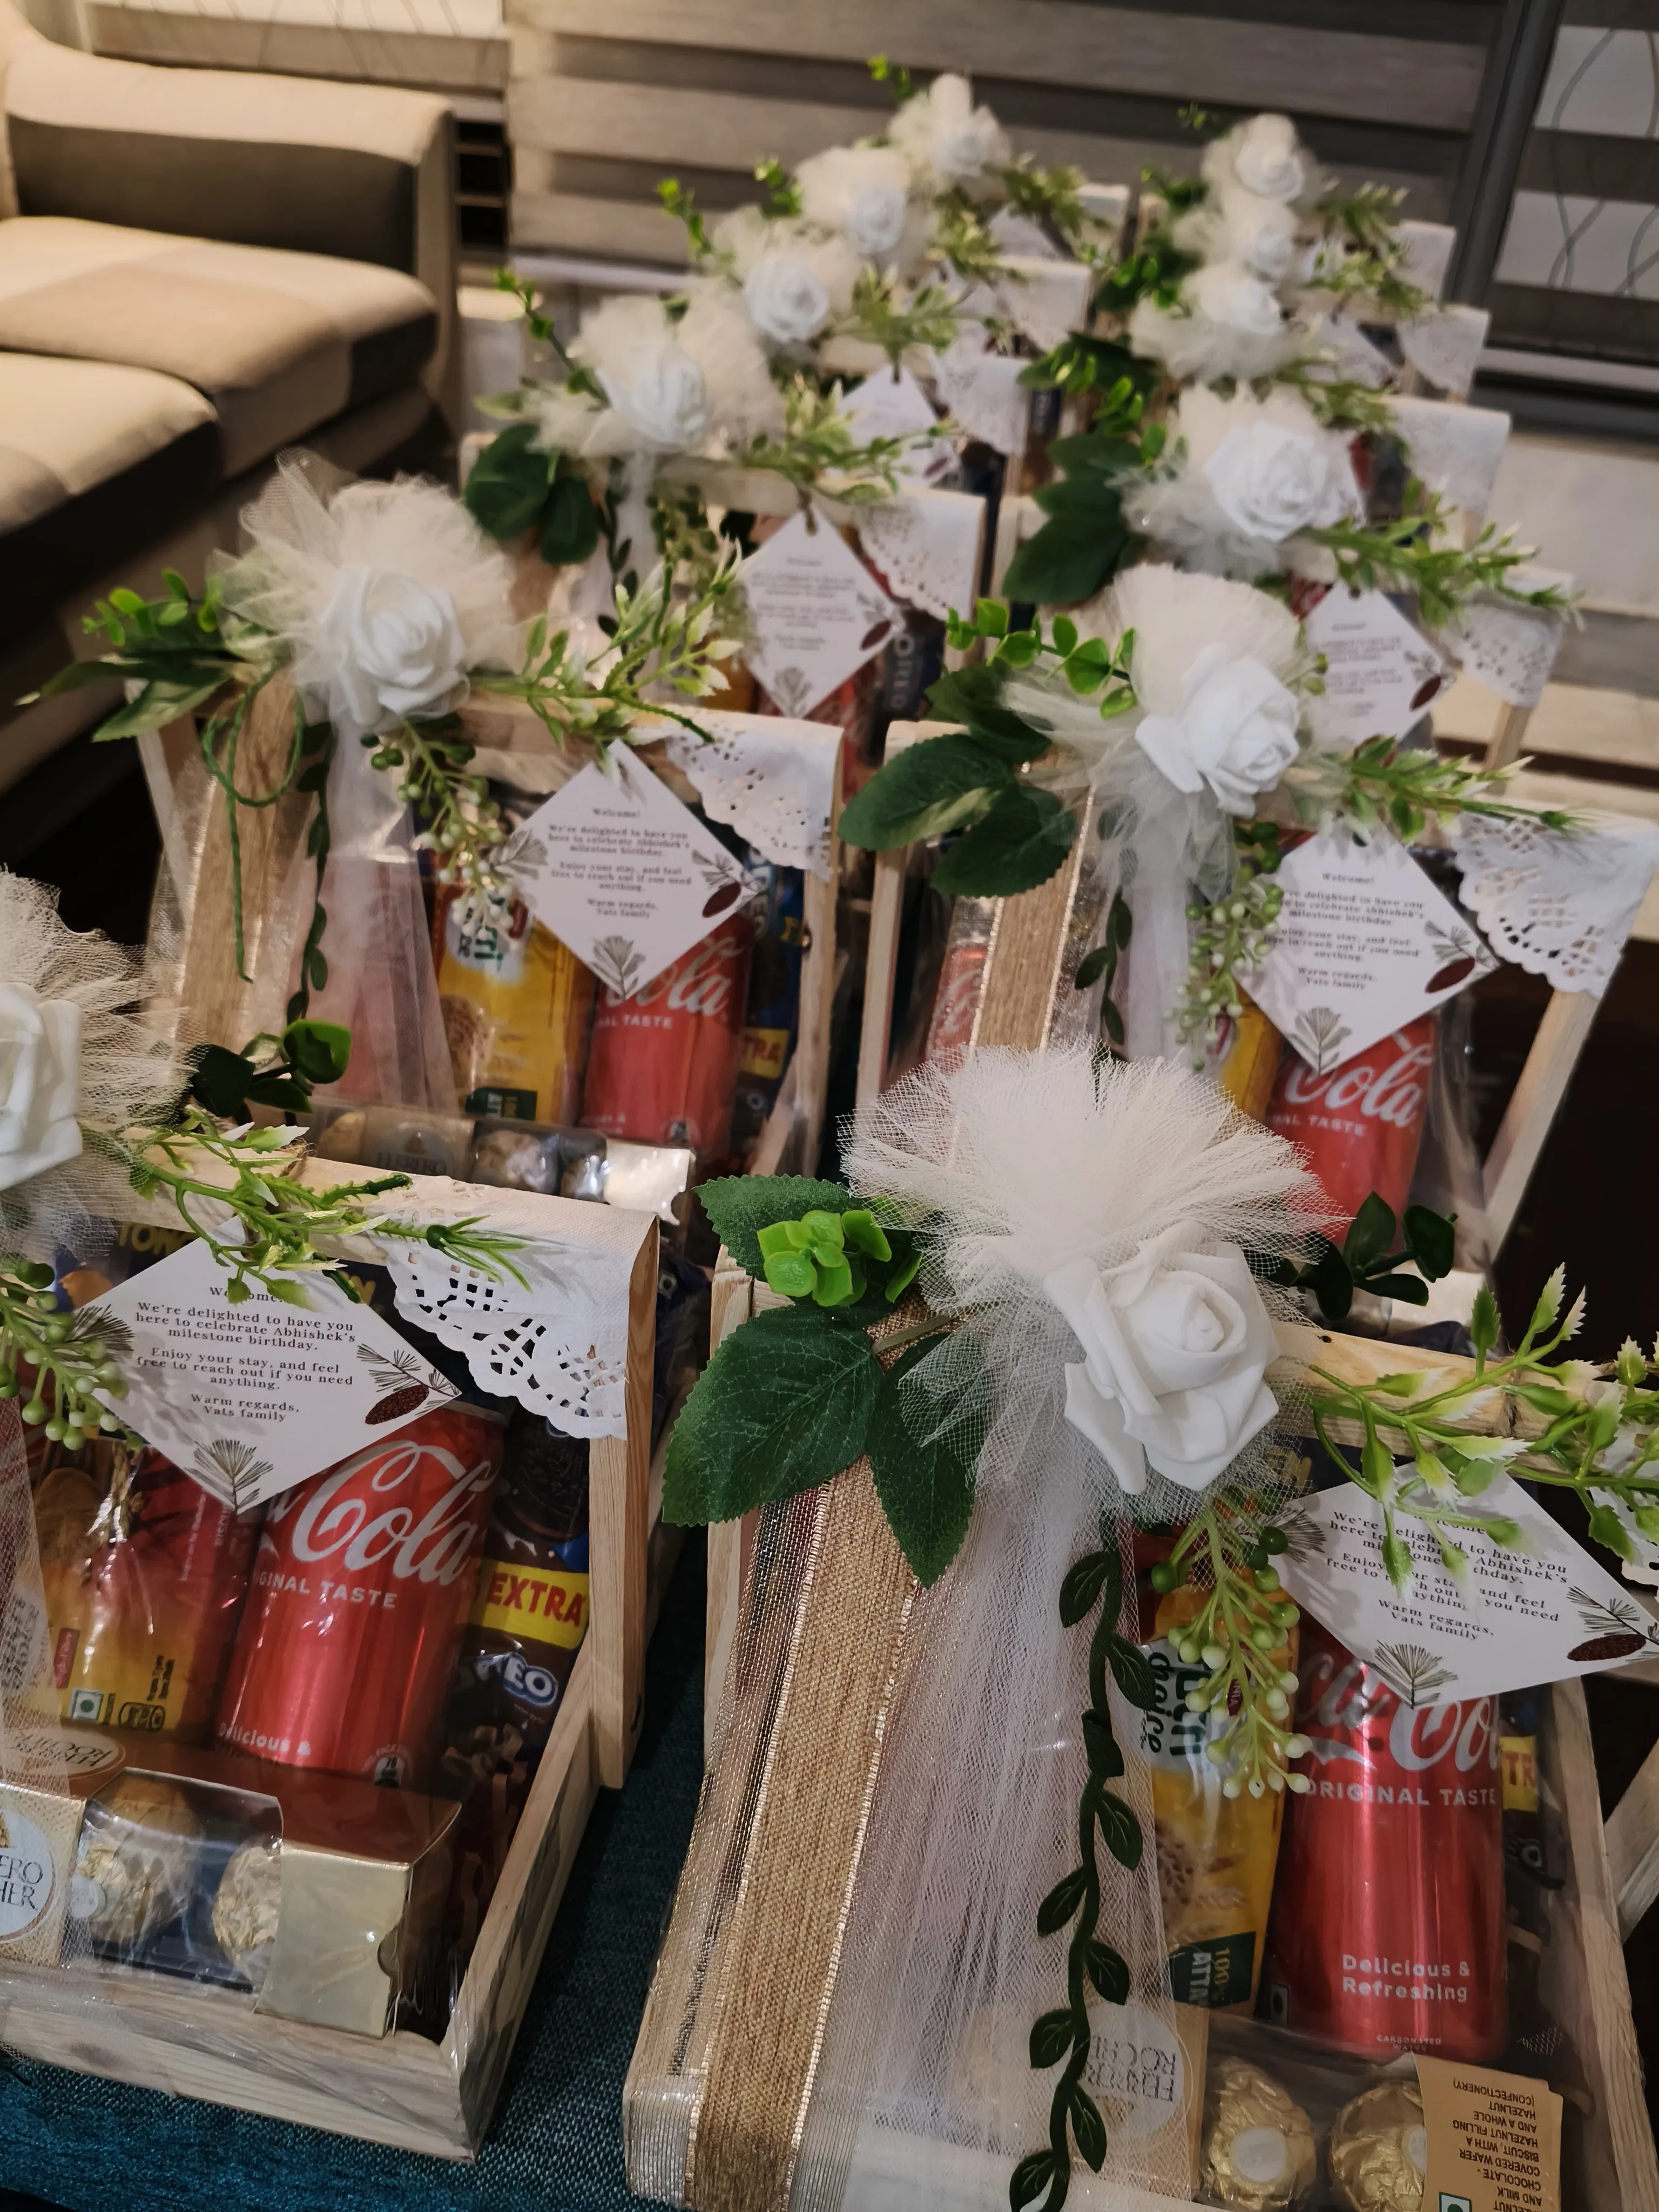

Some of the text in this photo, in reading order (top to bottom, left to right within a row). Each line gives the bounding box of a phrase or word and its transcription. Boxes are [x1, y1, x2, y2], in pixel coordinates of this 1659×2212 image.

[1309, 1114, 1366, 1138] TASTE
[136, 1311, 356, 1343] here to celebrate Abhishek's
[138, 1301, 353, 1332] We're delighted to have you
[168, 1328, 318, 1351] milestone birthday.
[137, 1356, 353, 1385] free to reach out if you need
[152, 1347, 192, 1361] Enjoy
[199, 1354, 233, 1364] your
[280, 1360, 306, 1371] and
[313, 1362, 339, 1373] feel
[210, 1375, 280, 1391] anything.
[191, 1393, 233, 1406] Warm
[203, 1405, 286, 1422] Vats family
[292, 1440, 499, 1586] Cola
[1330, 1520, 1365, 1536] here
[1333, 1511, 1379, 1530] We're
[1470, 1545, 1486, 1555] to
[1493, 1548, 1530, 1566] have
[1537, 1560, 1567, 1574] you
[1326, 1557, 1357, 1573] free
[1364, 1567, 1378, 1578] to
[1484, 1599, 1513, 1611] you
[1520, 1606, 1560, 1622] need
[1343, 1553, 1386, 1571] Enjoy
[1515, 1593, 1545, 1609] feel
[320, 1580, 397, 1609] TASTE
[488, 1572, 583, 1628] EXTRA
[1378, 1598, 1422, 1617] Warm
[1391, 1610, 1479, 1641] Vats family
[1440, 1788, 1496, 1806] TASTE
[1343, 1954, 1471, 1978] Delicious &
[1343, 1976, 1467, 2003] Refreshing
[1453, 2078, 1535, 2107] (CONFECTIONERY)
[1473, 2110, 1537, 2134] AND A WHOLE
[1488, 2101, 1536, 2120] HAZELNUT
[1452, 2119, 1538, 2148] HAZELNUT FILLING
[1465, 2136, 1473, 2146] A
[1475, 2138, 1498, 2153] WITH
[1459, 2148, 1540, 2177] COVERED WAFER
[1483, 2168, 1541, 2191] CHOCOLATE
[1496, 2186, 1542, 2207] AND MILK
